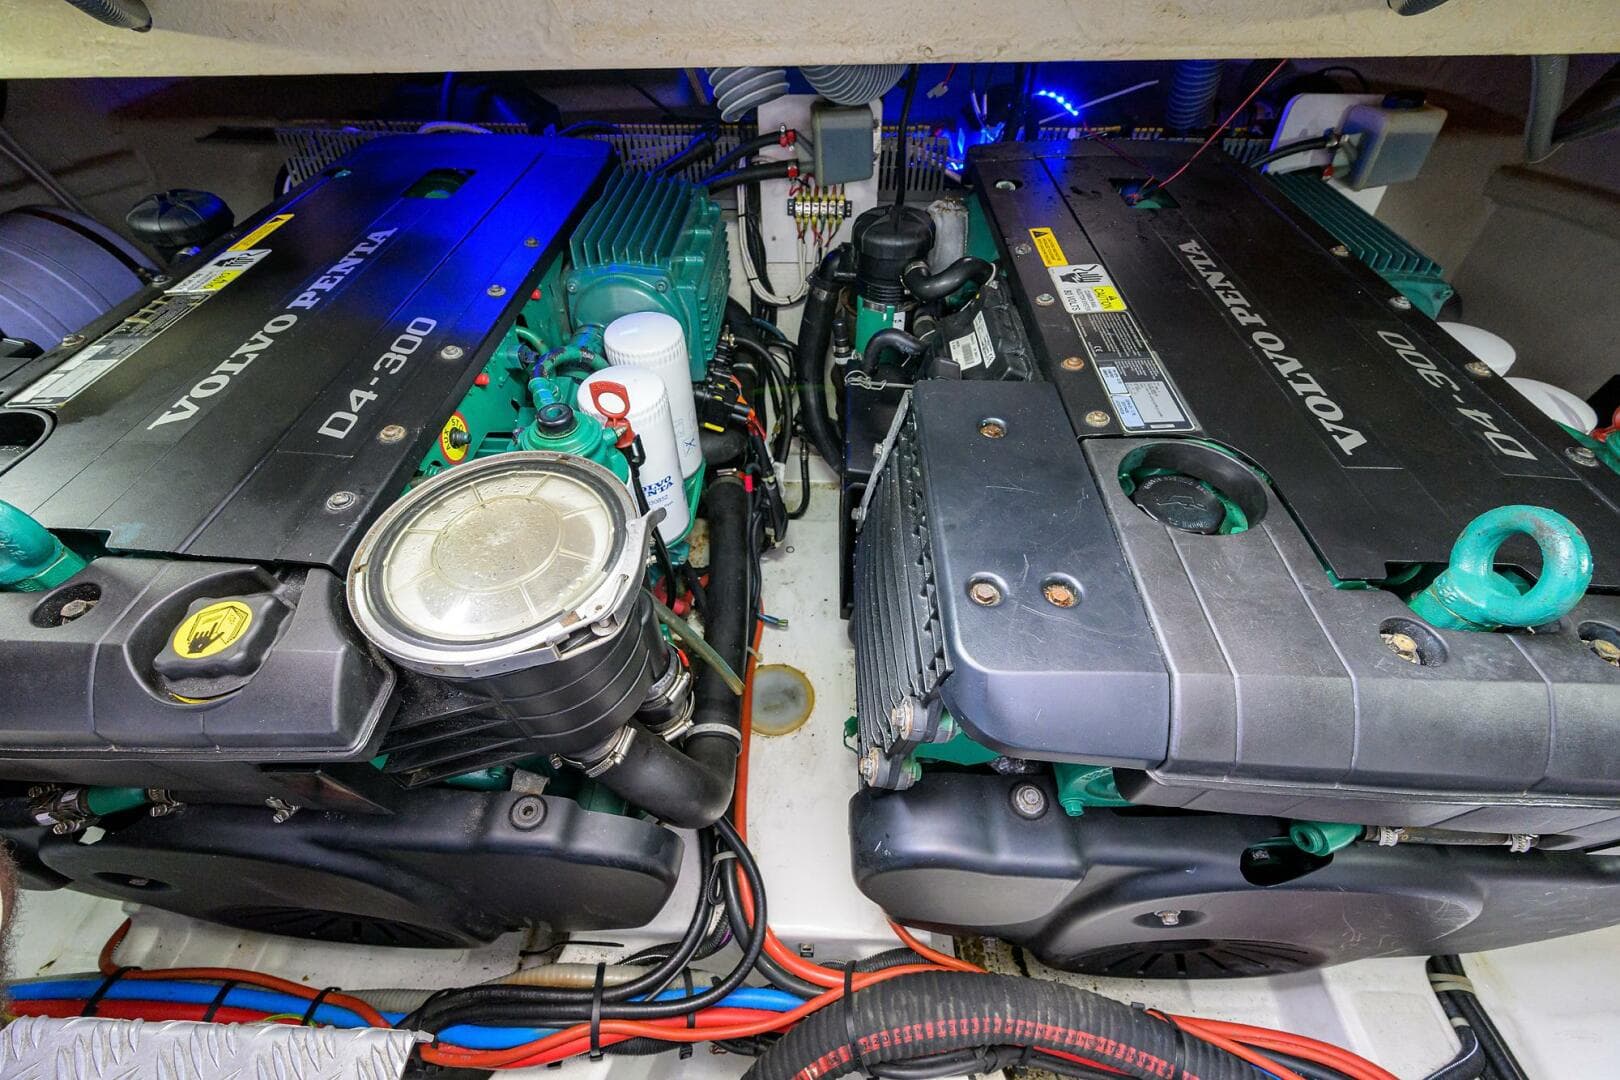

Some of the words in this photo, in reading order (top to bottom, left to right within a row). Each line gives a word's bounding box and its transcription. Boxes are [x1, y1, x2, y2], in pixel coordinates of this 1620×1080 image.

[147, 312, 298, 430] VOLVO
[286, 227, 399, 310] PENTA
[1178, 239, 1266, 327] PENTA
[318, 317, 437, 440] D4-300
[1252, 332, 1368, 456] VOLVO
[1378, 330, 1538, 461] D4-300
